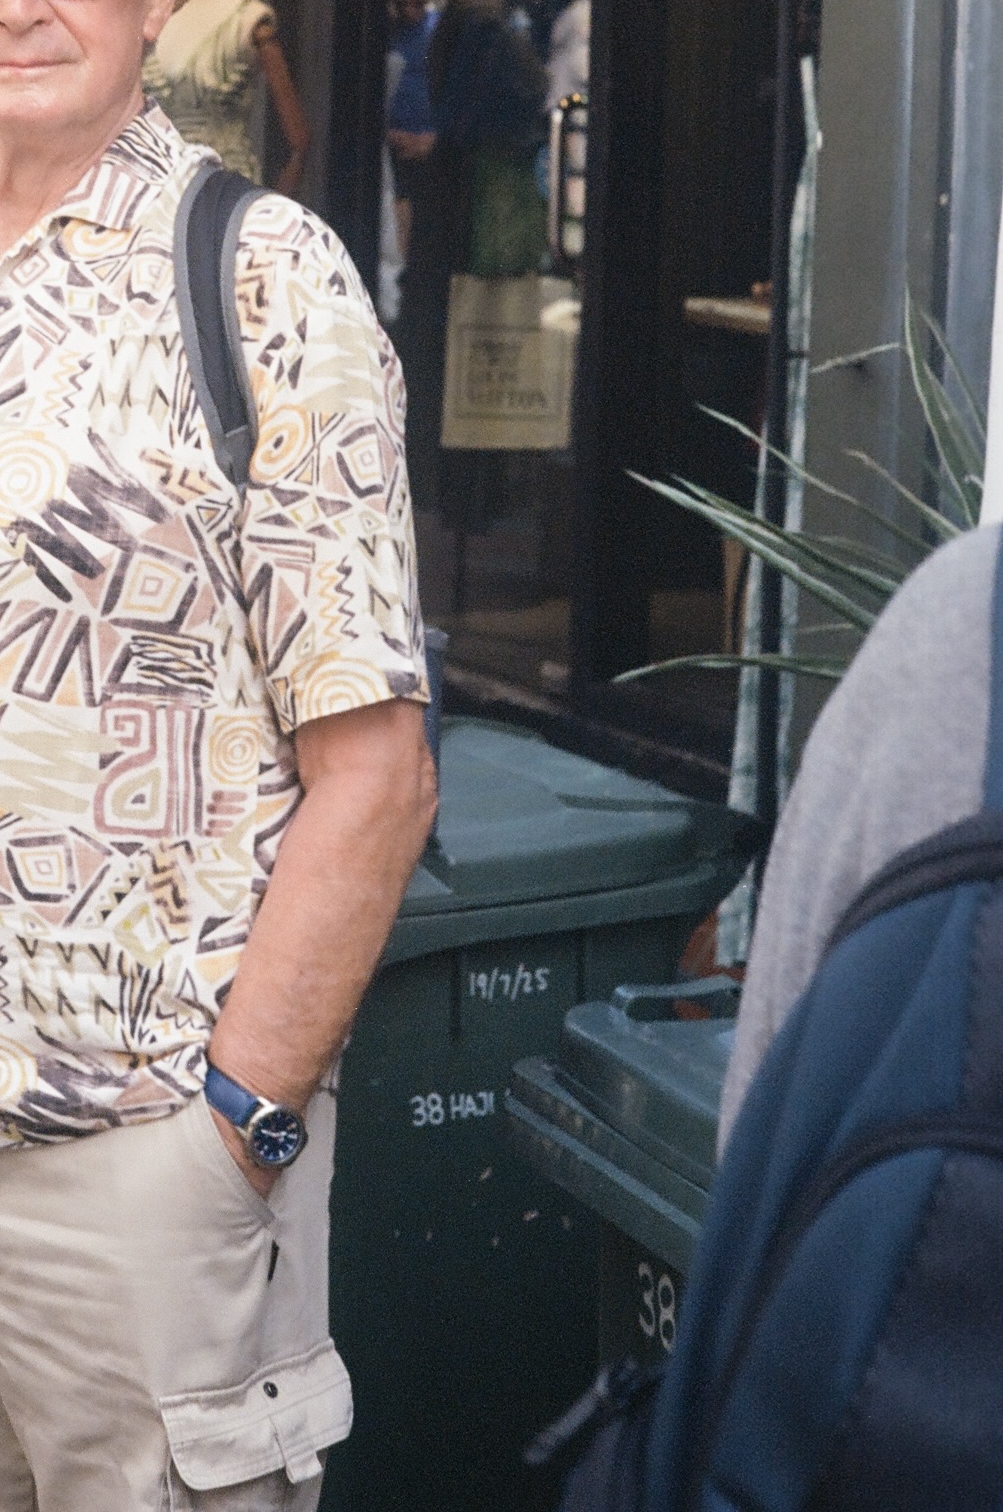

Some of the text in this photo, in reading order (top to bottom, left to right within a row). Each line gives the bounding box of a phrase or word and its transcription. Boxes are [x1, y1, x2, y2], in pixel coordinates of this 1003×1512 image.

[410, 1090, 495, 1127] 38 HAJI
[638, 1262, 676, 1352] 38
